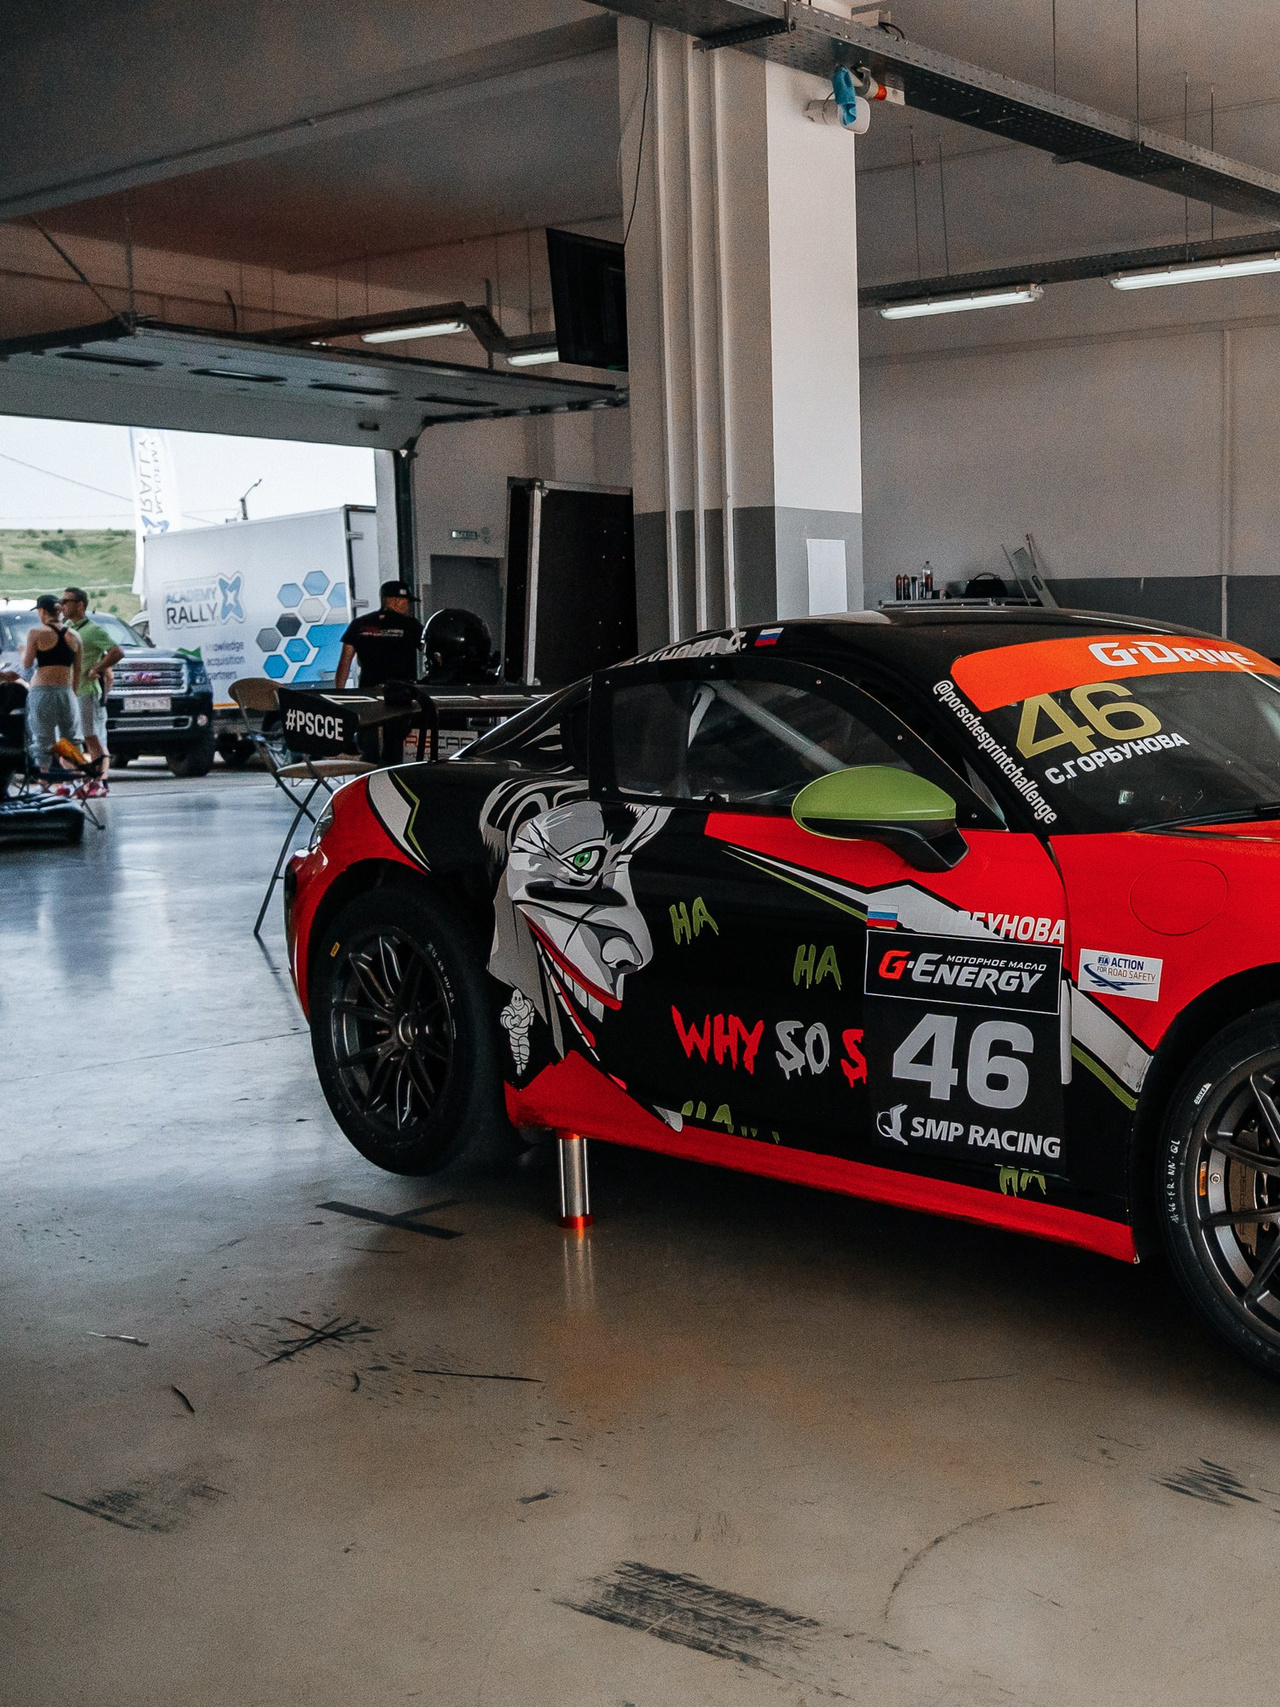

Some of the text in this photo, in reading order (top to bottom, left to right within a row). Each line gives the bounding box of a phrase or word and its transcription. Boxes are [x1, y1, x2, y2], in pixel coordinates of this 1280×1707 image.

[166, 602, 217, 625] RALLY
[285, 708, 344, 741] #PSCCE
[1015, 682, 1162, 759] 46
[932, 680, 1058, 825] @porschesprintchallenge
[1044, 732, 1190, 785] С.ГОРБУНОВА
[669, 896, 719, 945] HA
[793, 944, 842, 990] HA
[946, 955, 1047, 972] МОТОРНОЕ МАСЛО
[1098, 956, 1144, 971] FIA ACTION
[1108, 968, 1128, 978] ROAD
[1128, 971, 1156, 982] SAFETY
[671, 1004, 764, 1075] WHY
[775, 1020, 830, 1080] SO
[892, 1013, 1034, 1109] 46
[910, 1116, 1061, 1158] SMP RACING
